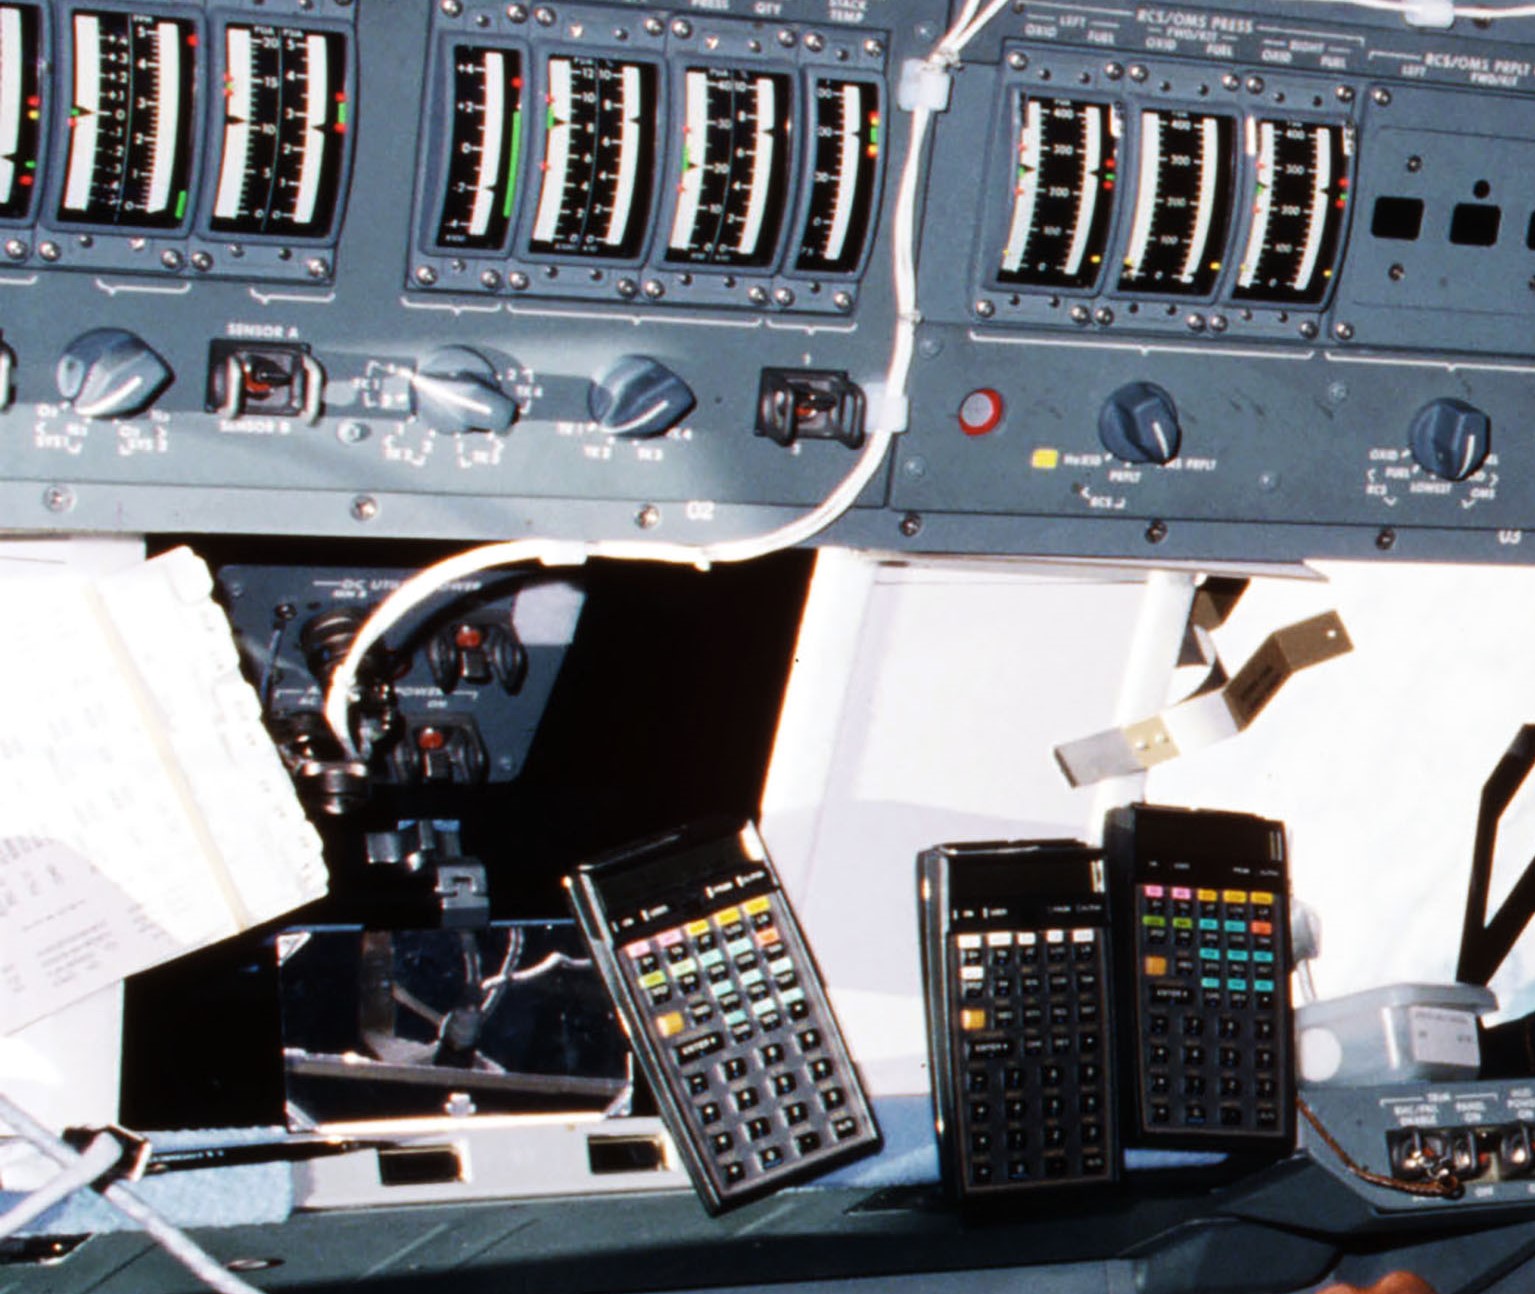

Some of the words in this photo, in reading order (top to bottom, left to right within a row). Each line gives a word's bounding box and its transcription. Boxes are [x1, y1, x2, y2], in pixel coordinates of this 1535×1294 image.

[829, 10, 864, 22] TEMP
[1136, 9, 1206, 29] RCS/OMS
[1211, 16, 1254, 33] PRESS
[1024, 24, 1058, 38] OXID
[1087, 30, 1115, 45] FUEL
[1145, 36, 1178, 51] OXID
[1205, 43, 1234, 58] FUEL
[1289, 39, 1325, 54] RIGHT
[1261, 50, 1292, 64] OXID
[1424, 53, 1489, 71] RCS/OMS
[1494, 60, 1530, 77] PRPLT
[227, 324, 279, 337] SENSOR
[219, 421, 273, 433] SENSOR
[1185, 458, 1217, 471] PRPLT
